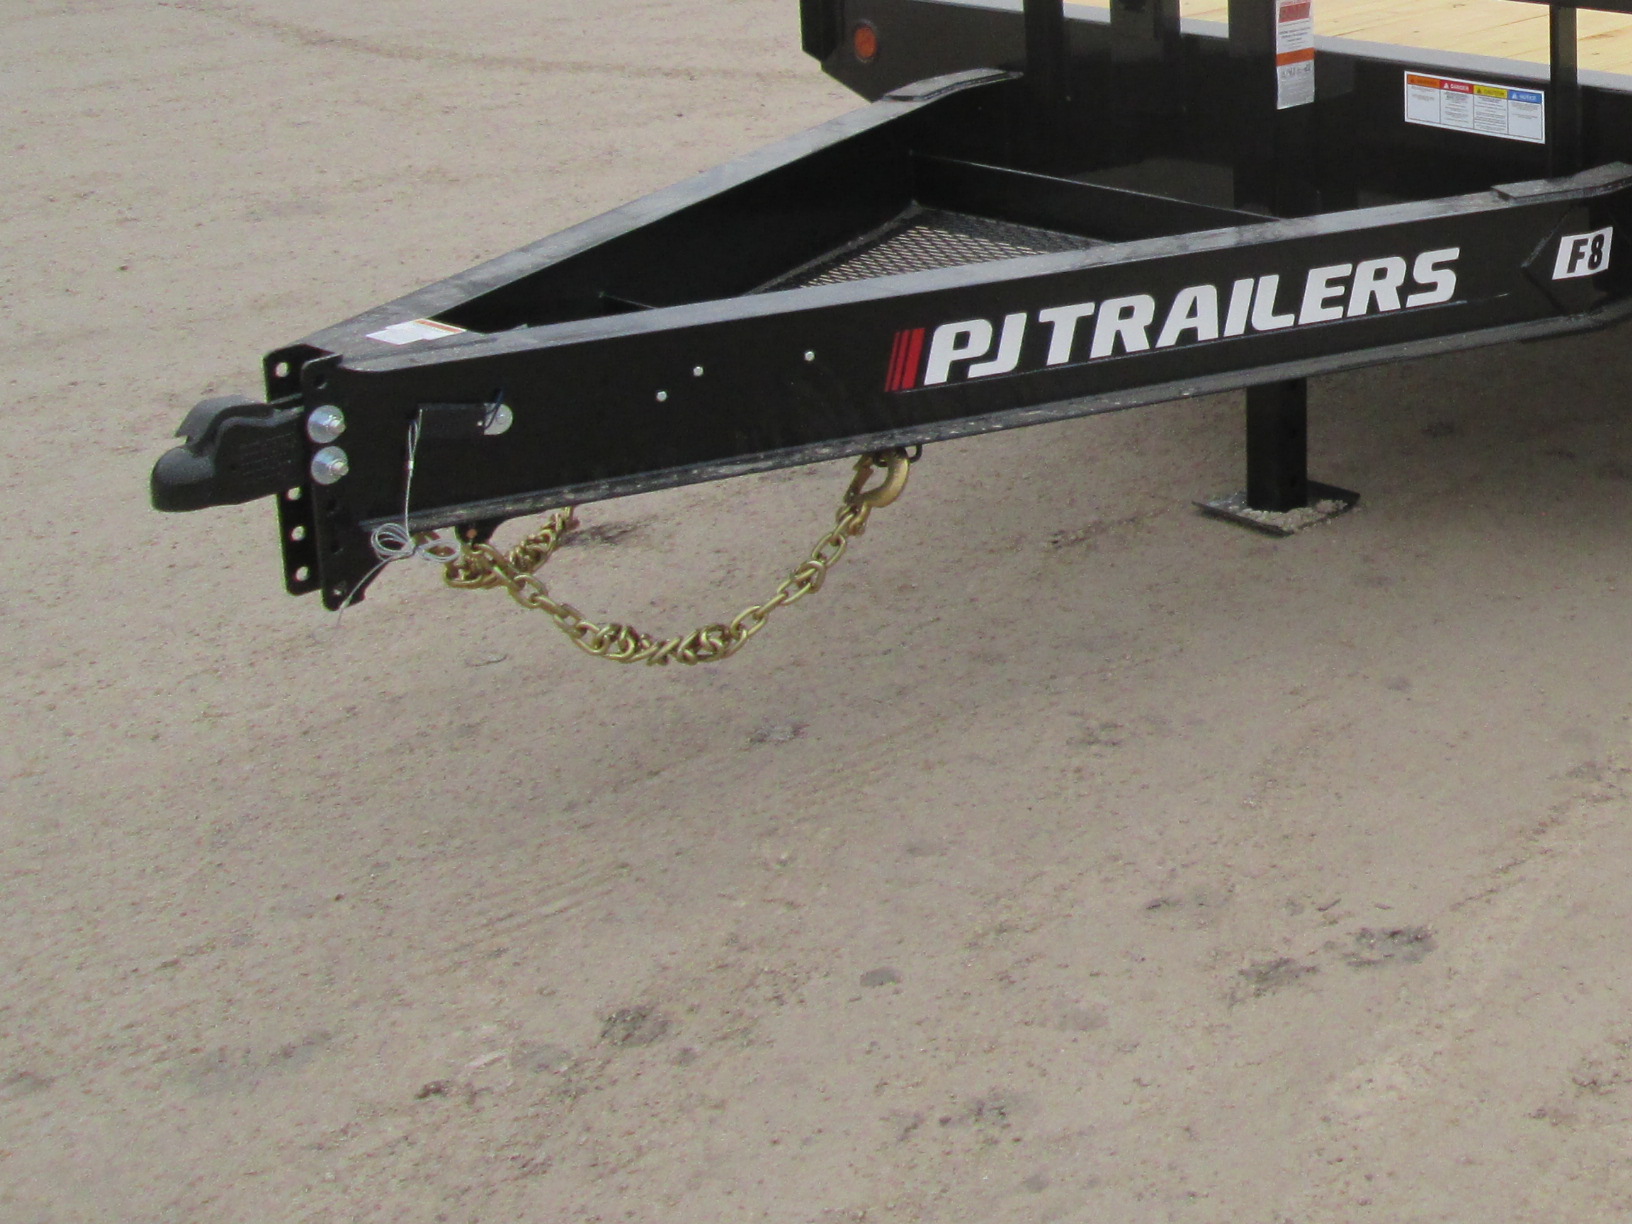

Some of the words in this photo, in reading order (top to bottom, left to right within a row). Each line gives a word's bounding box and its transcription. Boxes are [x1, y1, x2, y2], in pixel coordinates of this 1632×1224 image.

[1566, 233, 1605, 274] F8
[923, 312, 1028, 386] PJ
[1039, 247, 1461, 367] TRAILERS
